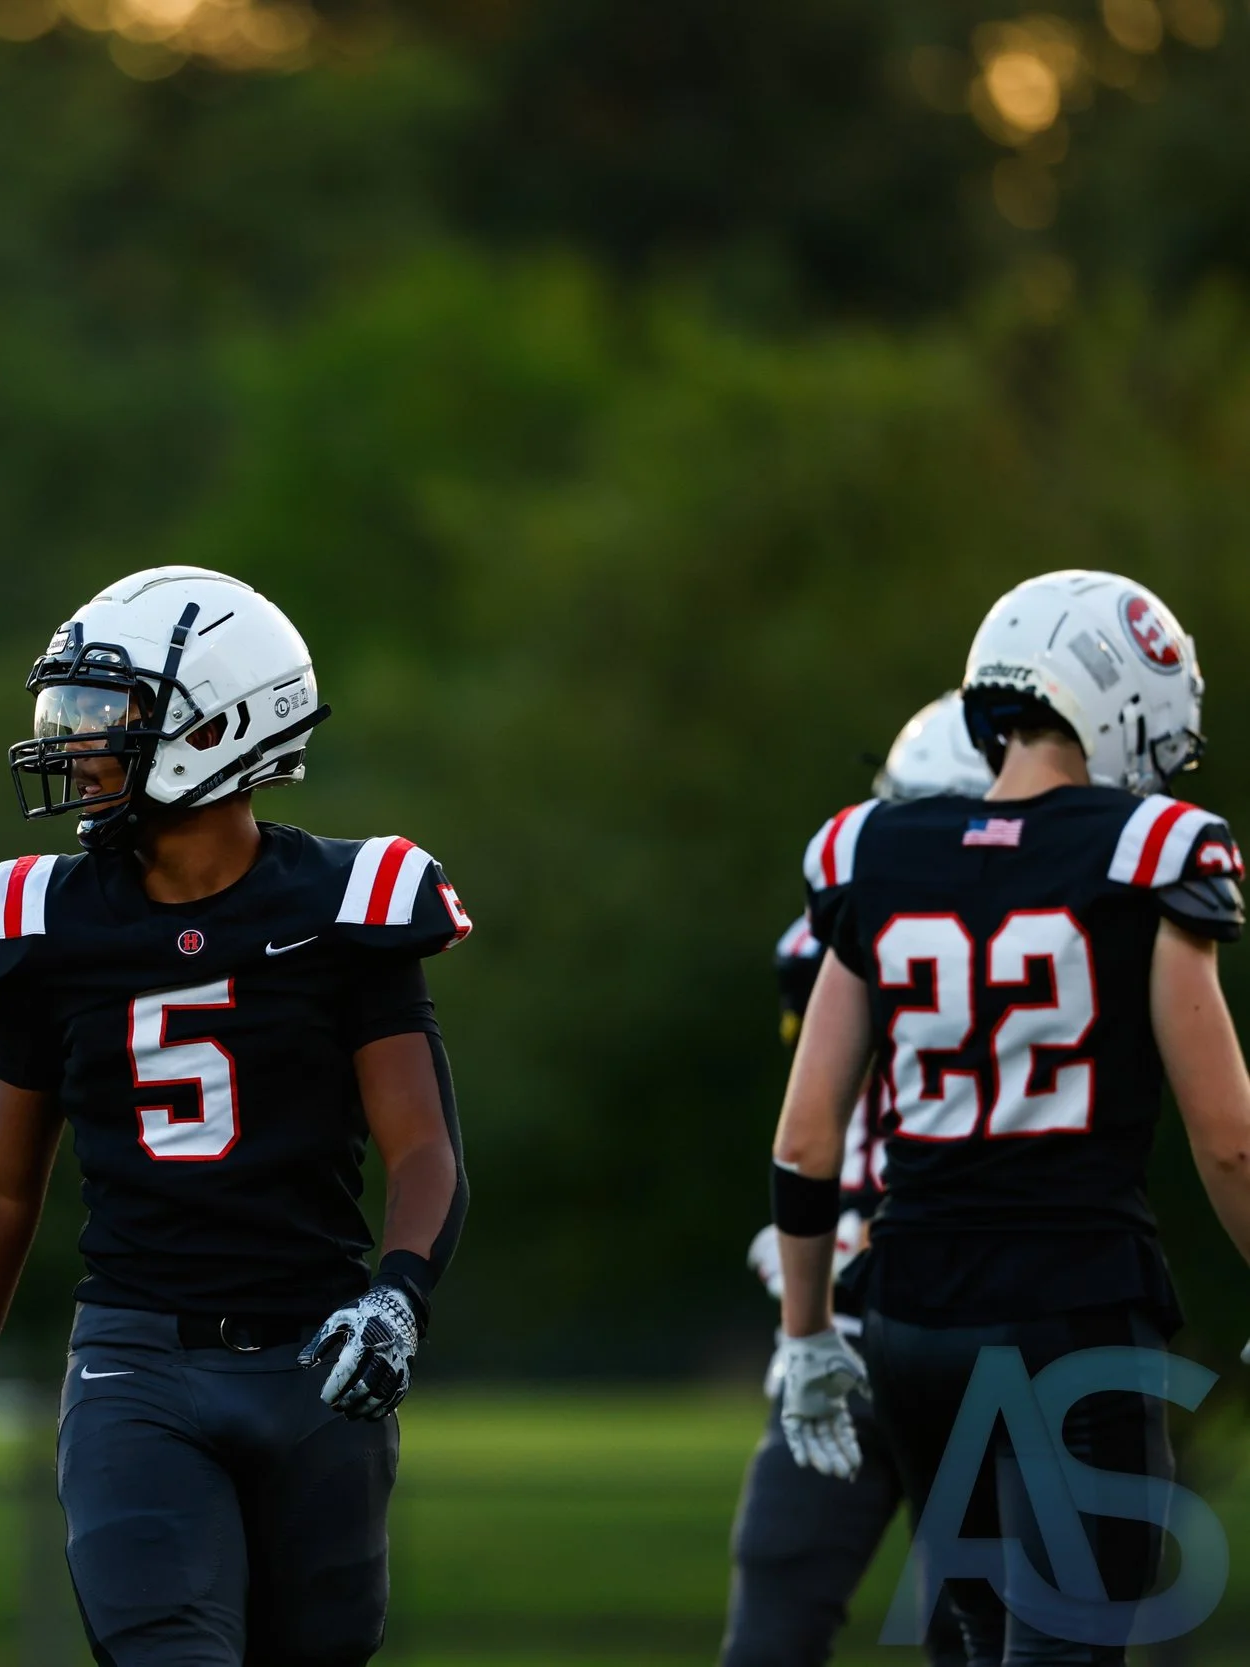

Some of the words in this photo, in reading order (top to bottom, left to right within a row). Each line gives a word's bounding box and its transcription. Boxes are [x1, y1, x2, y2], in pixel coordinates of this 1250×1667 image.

[183, 933, 198, 951] H
[873, 906, 1099, 1142] 22
[127, 976, 241, 1161] 5
